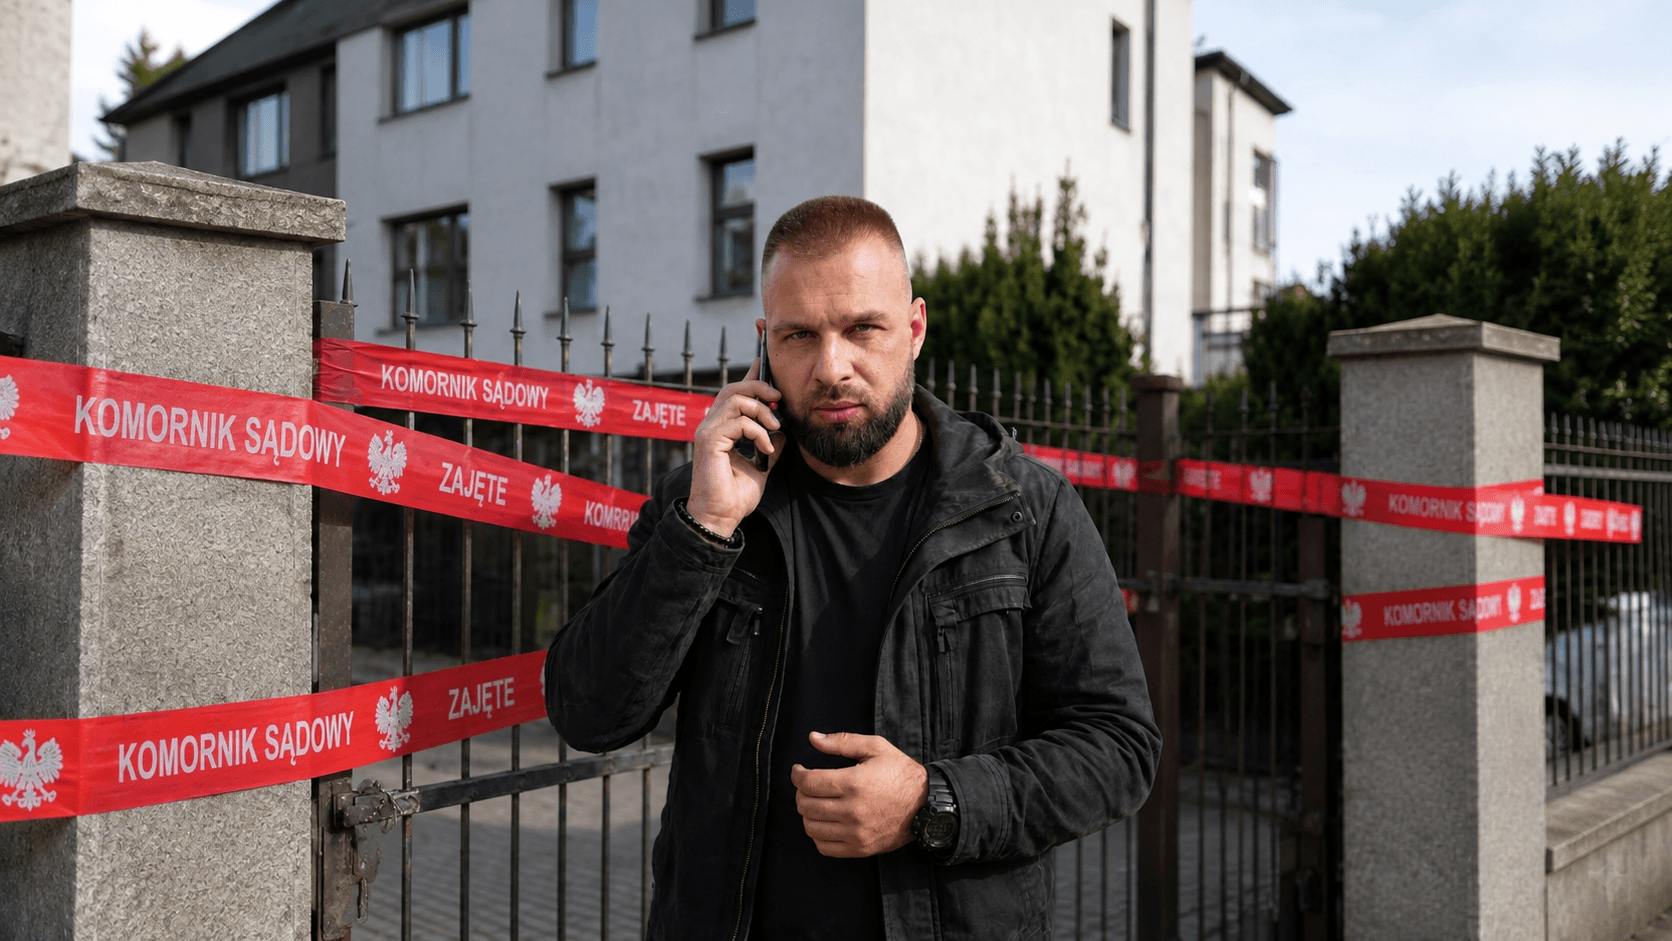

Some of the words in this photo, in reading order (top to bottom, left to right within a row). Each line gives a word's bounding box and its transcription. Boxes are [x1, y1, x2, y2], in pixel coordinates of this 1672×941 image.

[381, 364, 477, 400] KOMORNIK
[482, 378, 549, 410] SĄDOWY
[632, 399, 686, 429] ZAJĘTE
[74, 395, 236, 451] KOMORNIK
[244, 416, 346, 467] SĄDOWY
[439, 462, 508, 507] ZAJĘTE
[1387, 493, 1463, 521] KOMORNIK
[1383, 600, 1457, 627] KOMORNIK
[118, 726, 258, 783] KOMORNIK
[264, 711, 354, 766] SĄDOWY
[448, 677, 515, 719] ZAJĘTE
